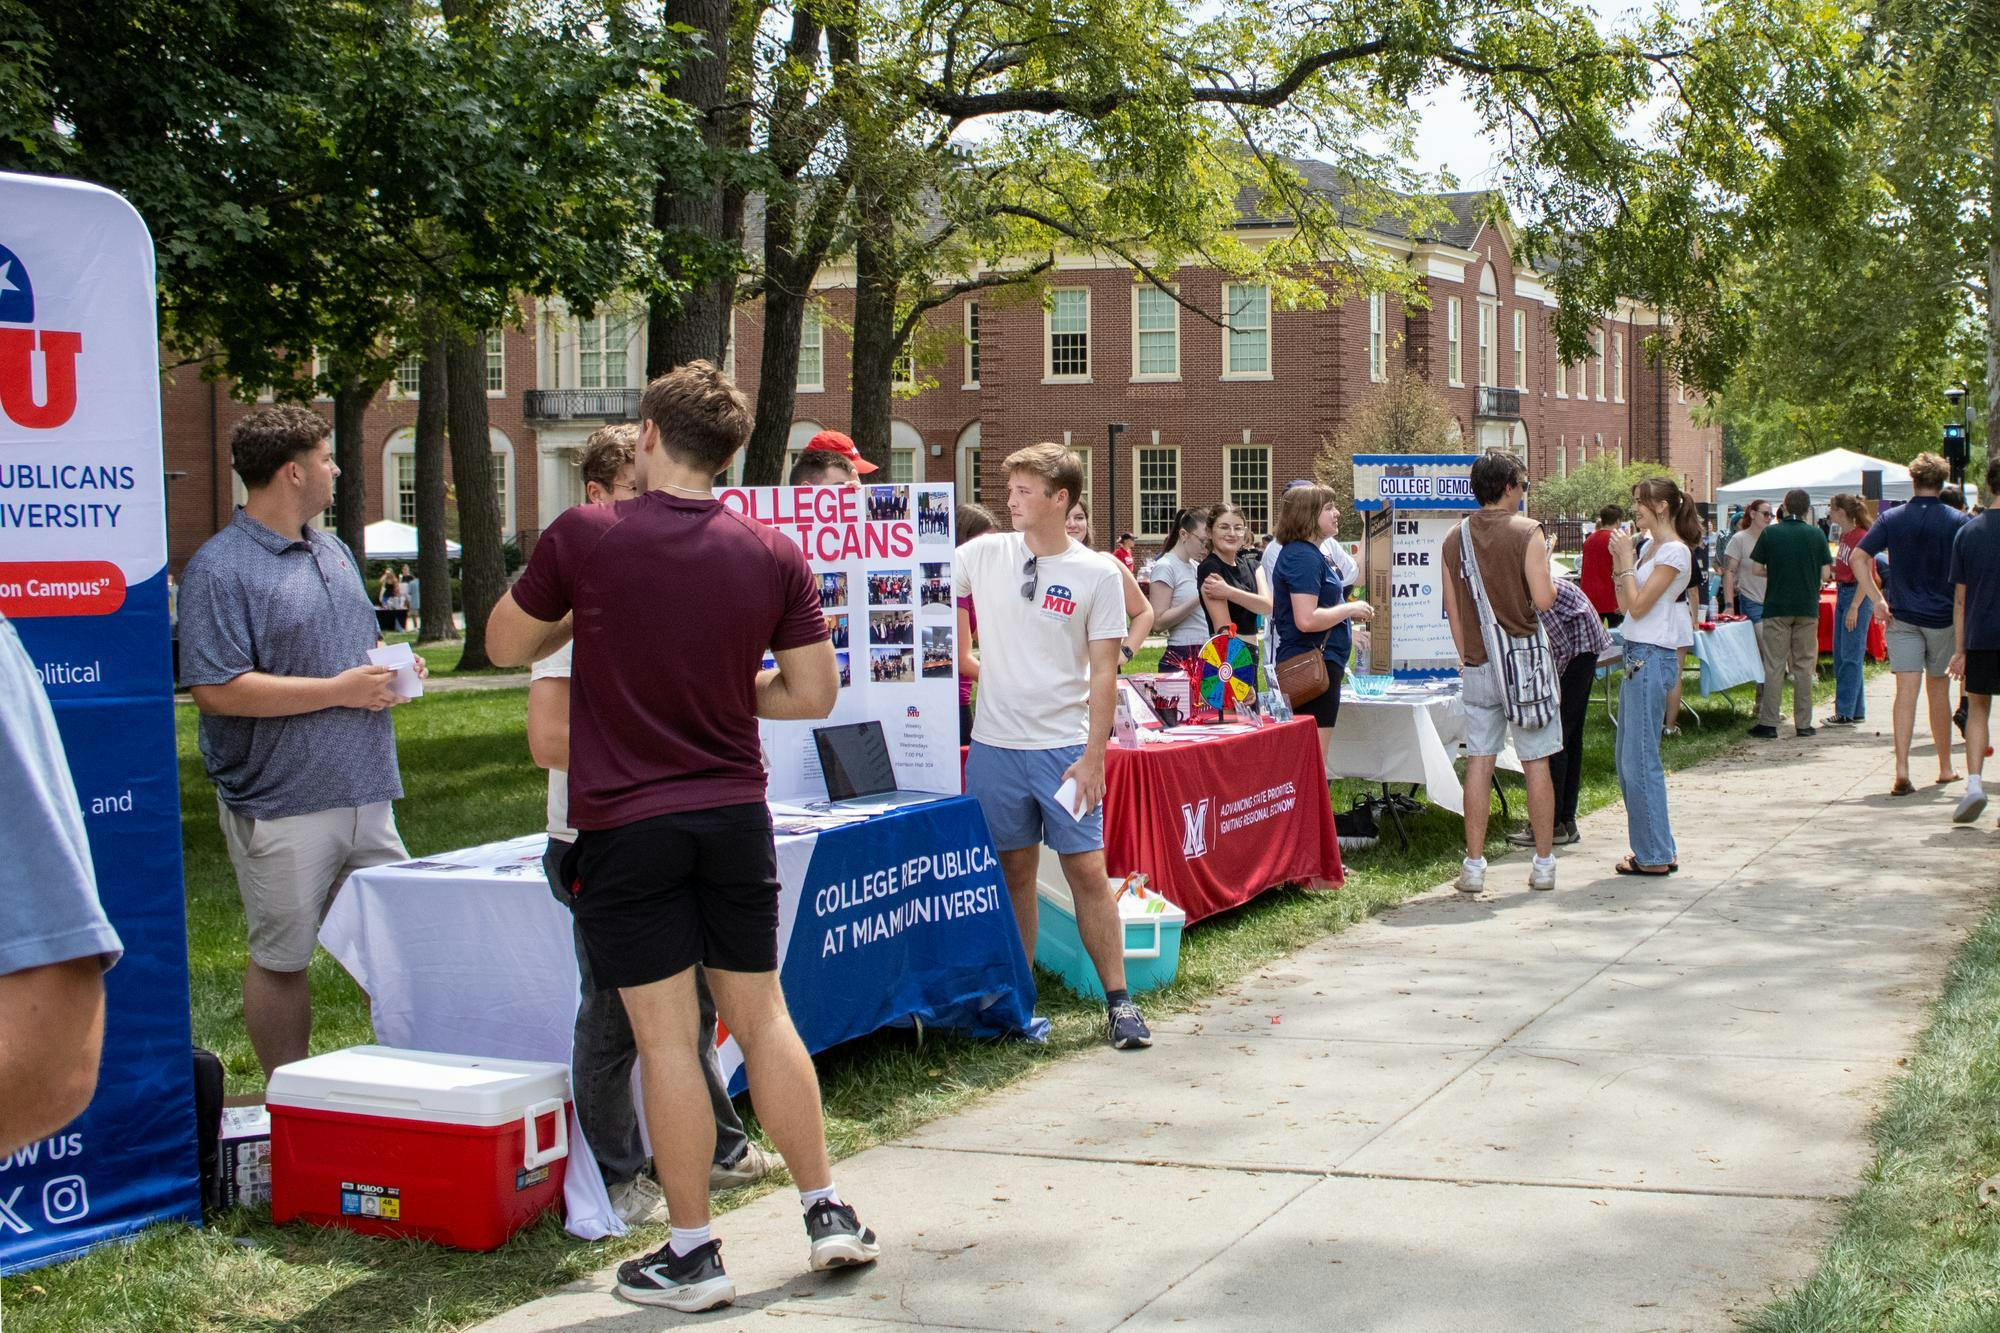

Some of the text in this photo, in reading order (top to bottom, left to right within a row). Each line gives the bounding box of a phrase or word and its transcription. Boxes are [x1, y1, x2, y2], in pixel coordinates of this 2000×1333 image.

[1381, 478, 1431, 494] COLLEGE
[0, 582, 22, 598] on
[1042, 594, 1077, 616] MU
[92, 790, 133, 814] and
[1220, 796, 1252, 817] ADVANCING
[815, 866, 899, 918] COLLEGE
[822, 924, 848, 959] AT
[48, 1133, 83, 1160] US
